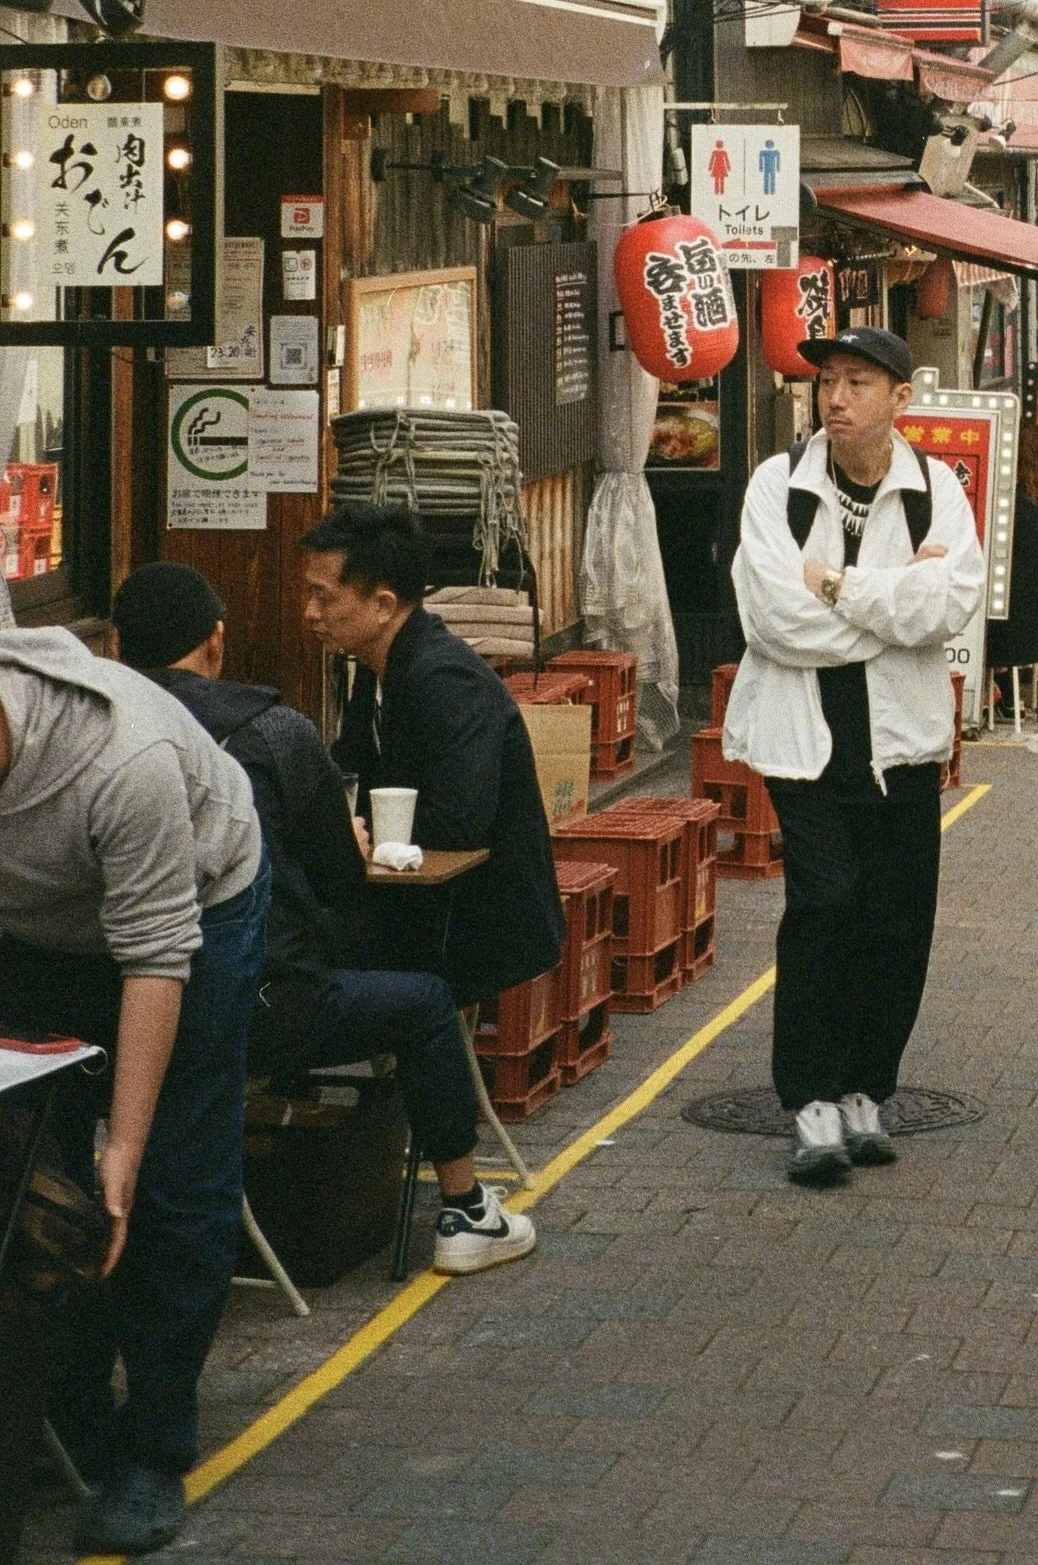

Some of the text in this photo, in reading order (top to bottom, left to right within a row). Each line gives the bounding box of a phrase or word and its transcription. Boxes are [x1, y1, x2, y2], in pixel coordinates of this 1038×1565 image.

[48, 115, 88, 130] Oden
[49, 133, 150, 275] おでん
[718, 203, 770, 222] トイレ
[725, 224, 764, 236] Toilets
[646, 254, 690, 368] 呑ませます
[678, 238, 729, 329] 旨い酒
